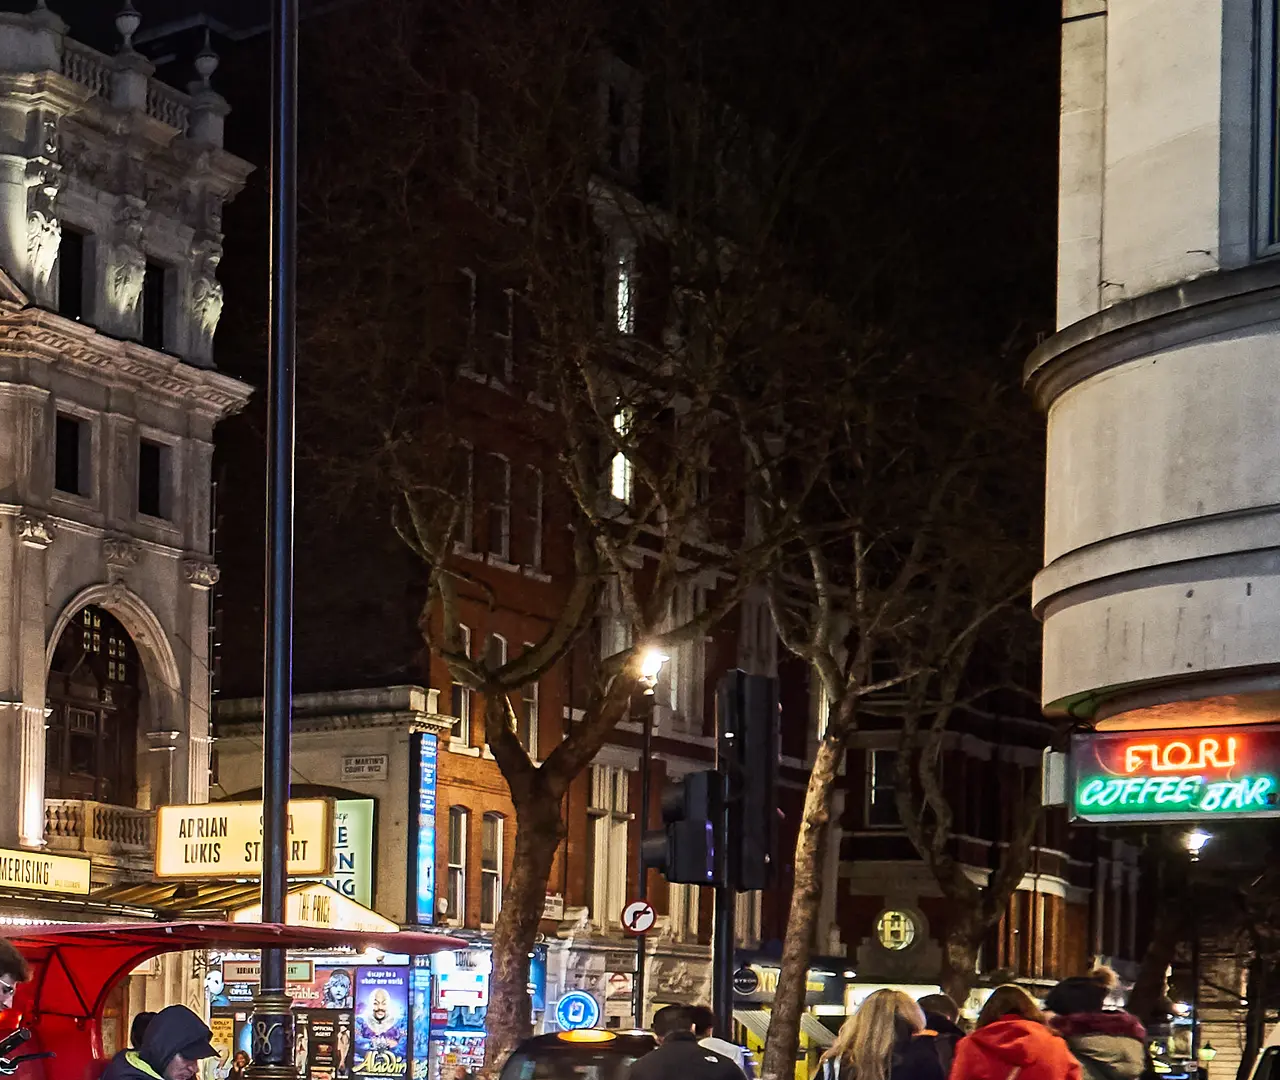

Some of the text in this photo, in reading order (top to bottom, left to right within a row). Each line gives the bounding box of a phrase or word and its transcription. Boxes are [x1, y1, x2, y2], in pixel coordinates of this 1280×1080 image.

[1125, 736, 1238, 772] FIORI
[1080, 776, 1272, 812] COFFEE BAR
[179, 816, 228, 839] ADRIAN
[184, 842, 221, 864] LUKIS
[312, 892, 332, 924] PRICE
[352, 1050, 408, 1074] Aladdin
